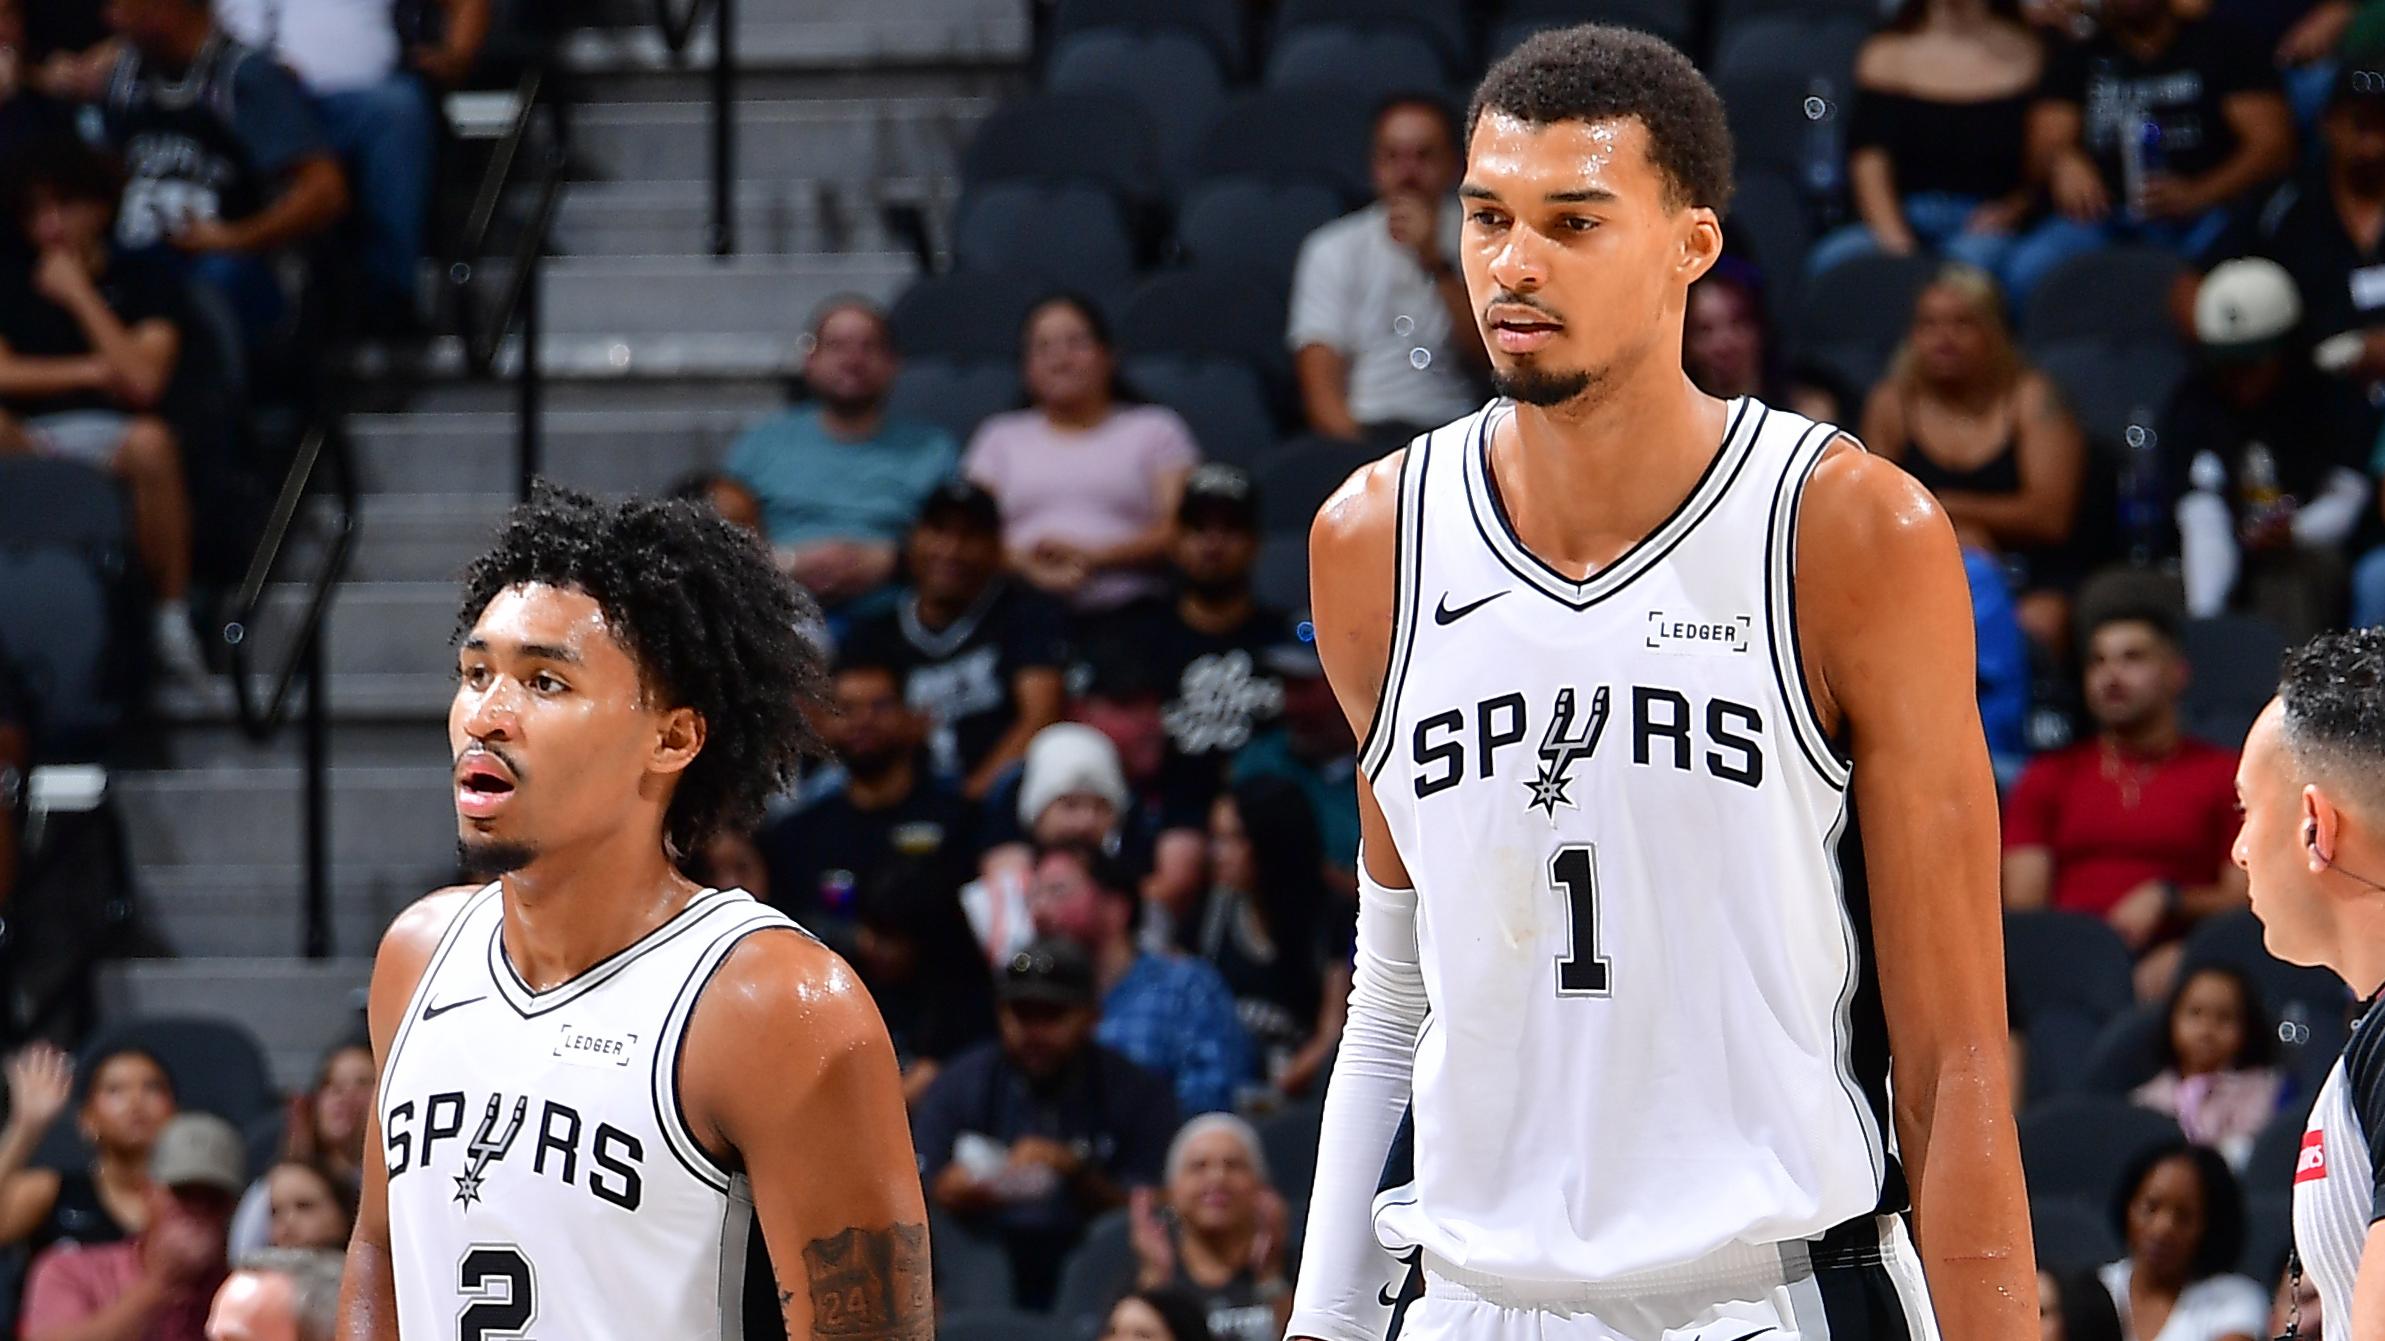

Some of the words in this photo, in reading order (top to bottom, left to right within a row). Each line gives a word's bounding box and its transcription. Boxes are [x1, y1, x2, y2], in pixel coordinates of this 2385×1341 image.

[1660, 622, 1736, 642] LEDGER
[1413, 685, 1763, 820] SPURS
[1547, 842, 1612, 998] 1
[565, 1035, 624, 1056] LEDGER
[388, 1091, 644, 1214] SPURS
[456, 1243, 538, 1341] 2
